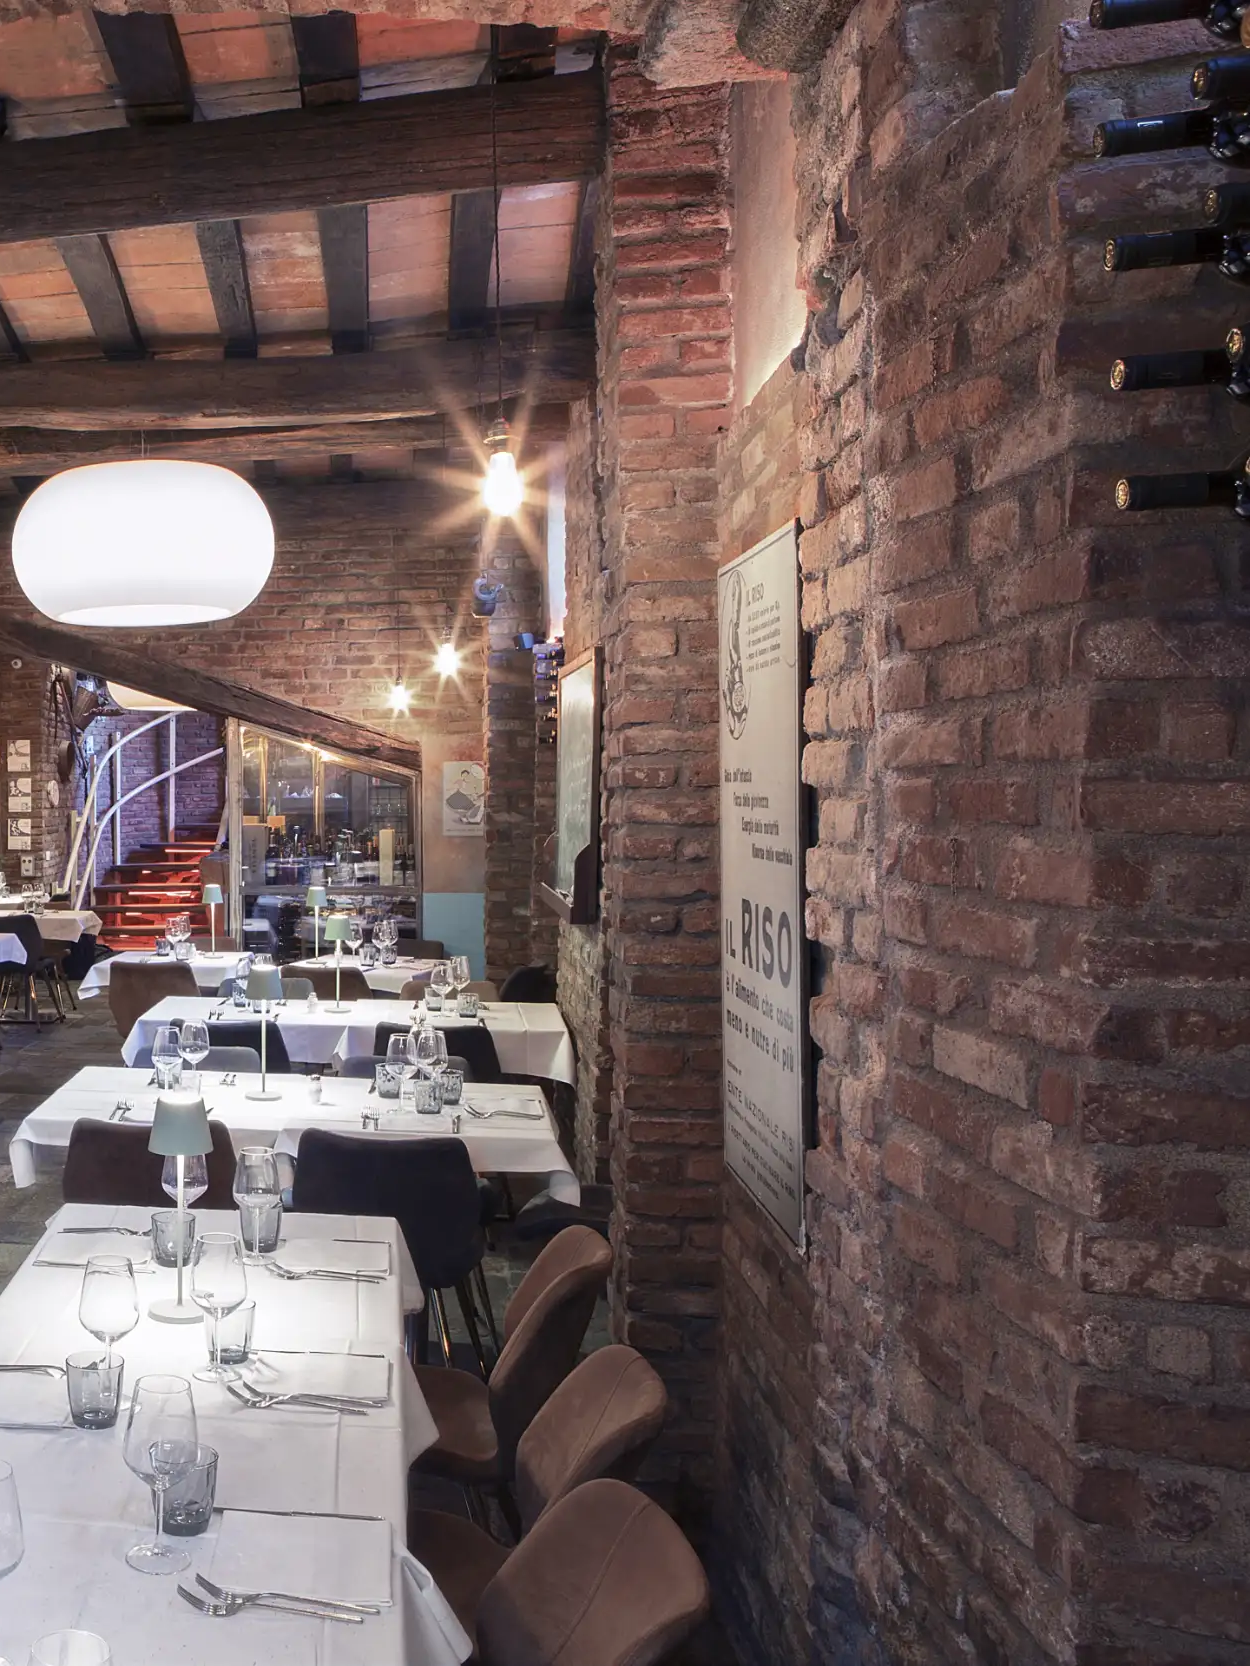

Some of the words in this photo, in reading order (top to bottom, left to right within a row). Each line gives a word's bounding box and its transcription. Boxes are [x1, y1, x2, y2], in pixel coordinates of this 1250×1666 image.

[725, 918, 735, 959] IL
[741, 897, 792, 989] RISO
[726, 1007, 742, 1035] meno
[751, 1021, 769, 1056] nutre
[772, 1035, 778, 1063] di
[776, 1001, 793, 1034] costa
